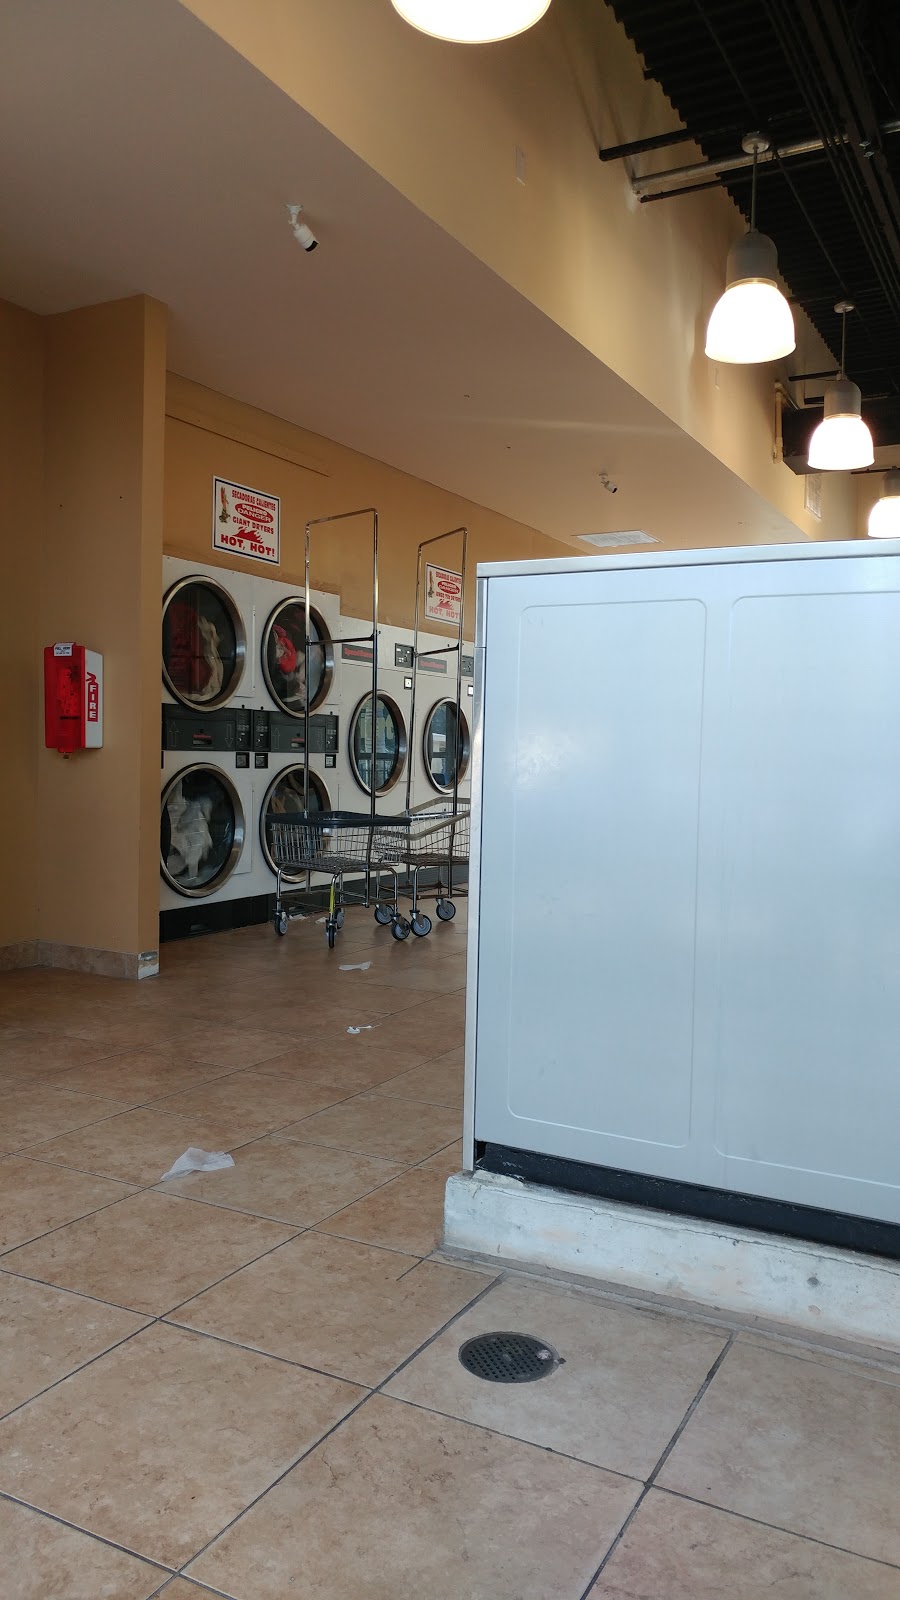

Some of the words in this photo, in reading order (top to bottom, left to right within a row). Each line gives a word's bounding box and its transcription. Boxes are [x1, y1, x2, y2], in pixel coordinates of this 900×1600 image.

[232, 490, 255, 504] SECADORAS
[238, 508, 271, 522] DANGER
[233, 516, 250, 527] GIANT
[252, 522, 274, 534] DRYERS
[221, 534, 245, 550] HOT,
[250, 542, 275, 557] HOT!
[89, 684, 97, 719] FIRE
